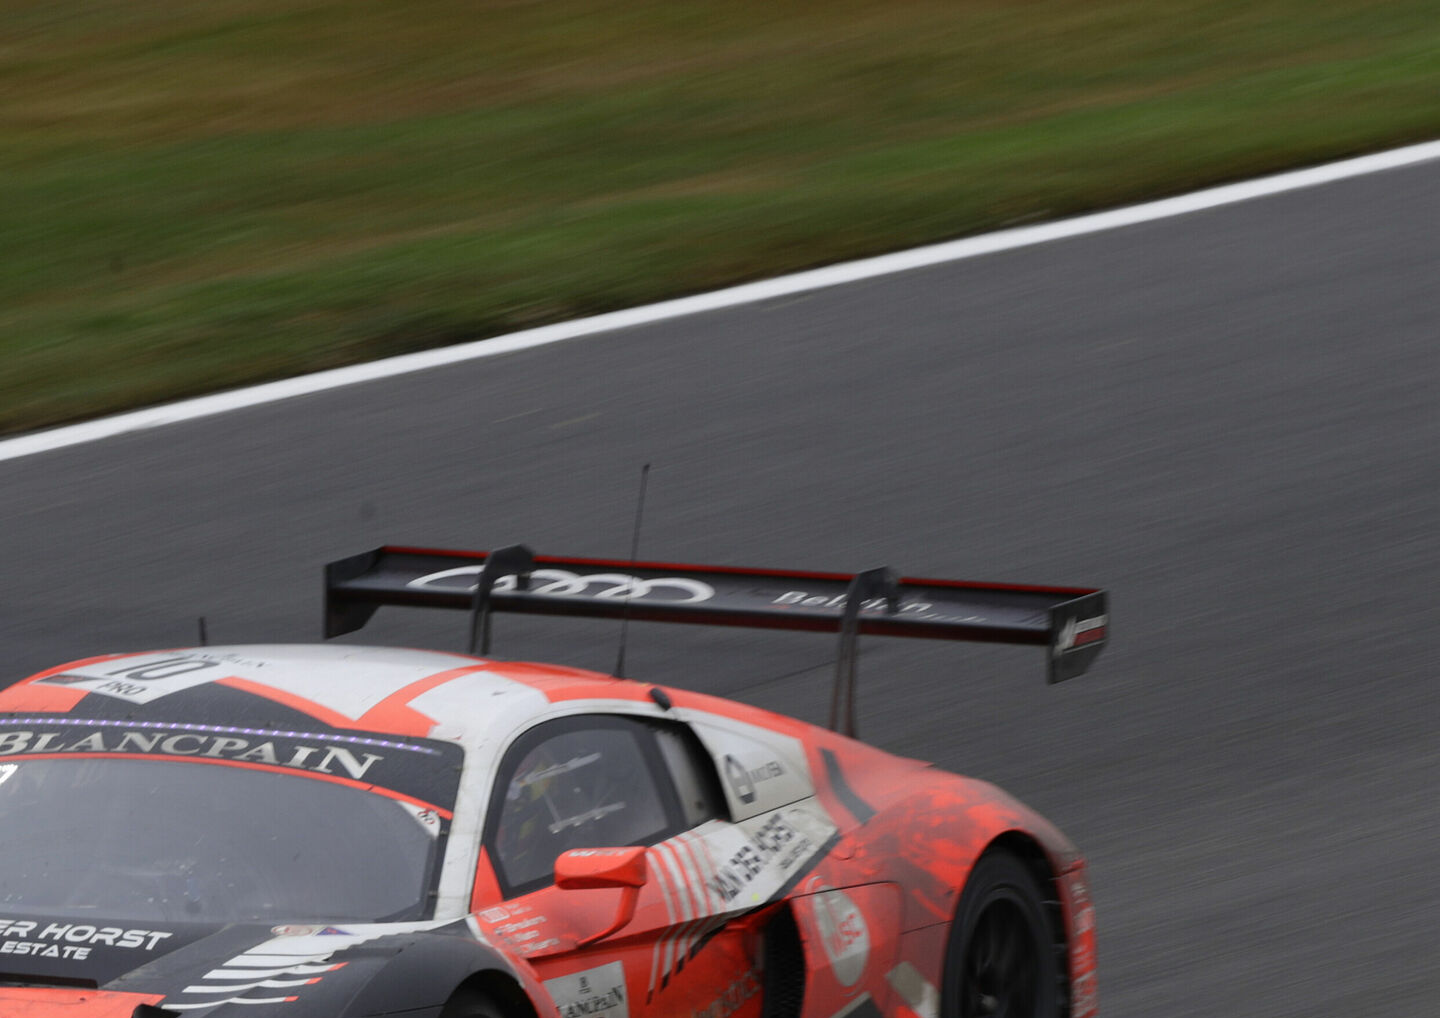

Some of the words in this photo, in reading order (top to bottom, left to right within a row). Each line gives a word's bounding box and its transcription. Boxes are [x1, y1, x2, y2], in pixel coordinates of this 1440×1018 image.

[98, 680, 148, 696] PRO
[38, 923, 173, 950] HORST
[0, 941, 92, 960] ESTATE
